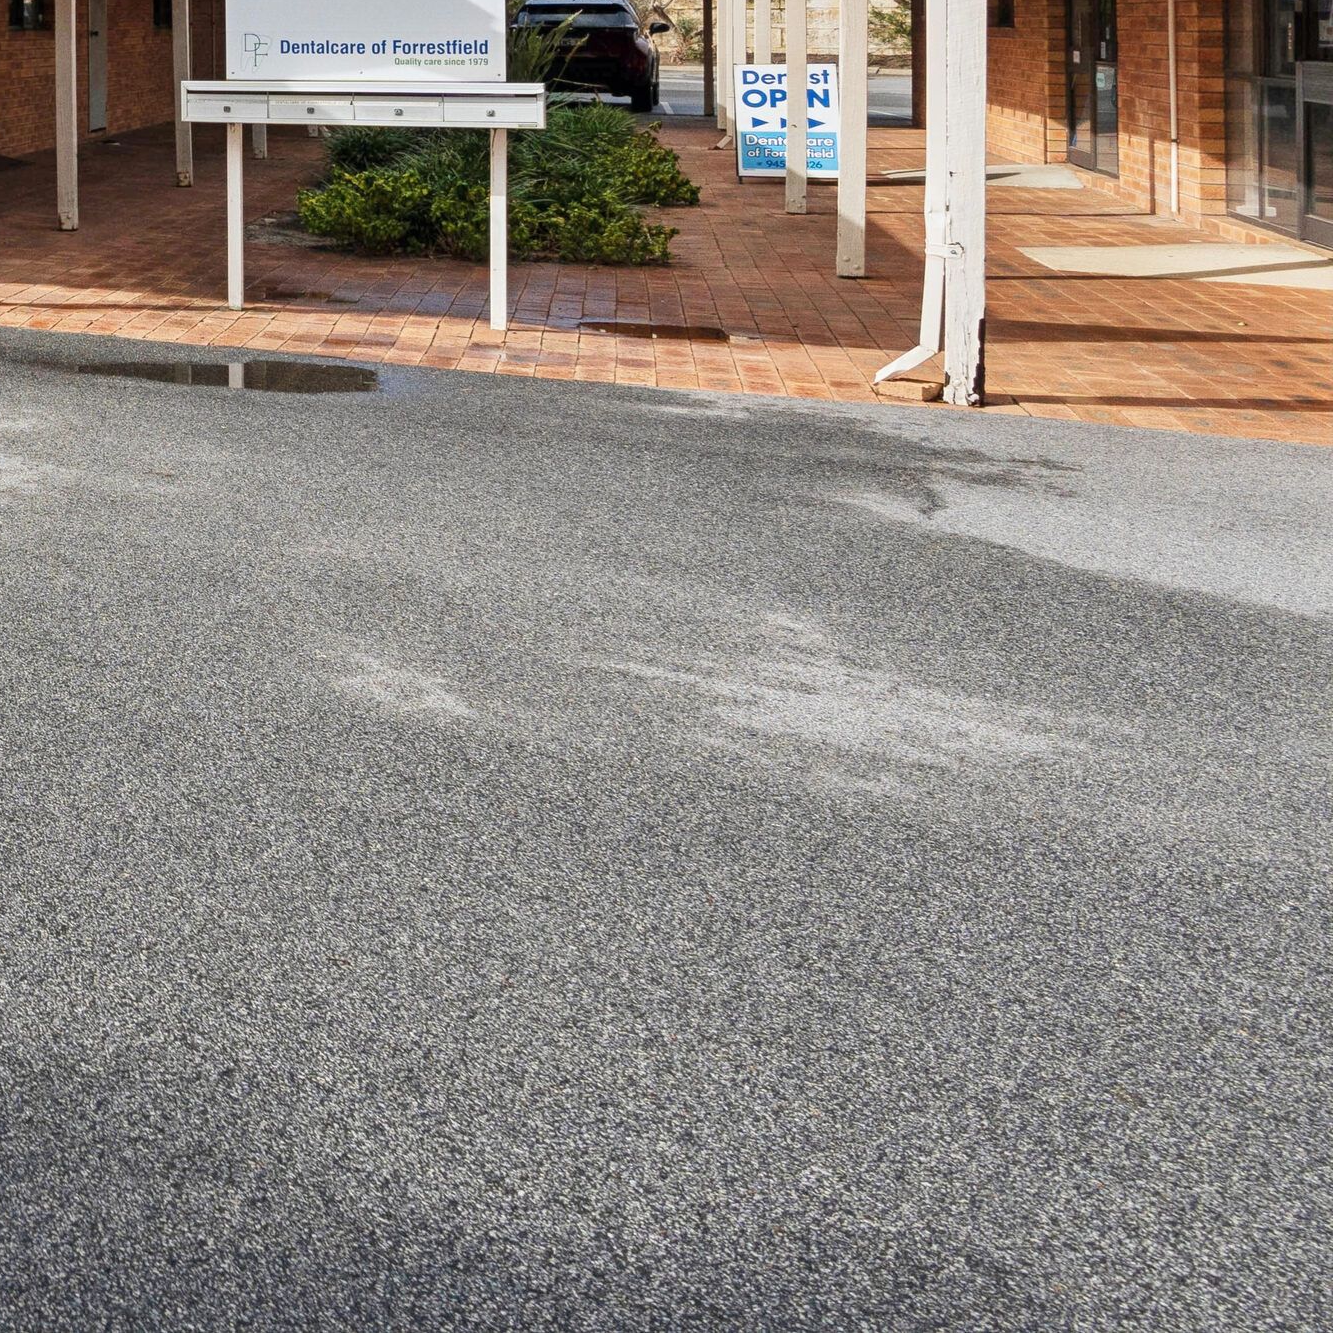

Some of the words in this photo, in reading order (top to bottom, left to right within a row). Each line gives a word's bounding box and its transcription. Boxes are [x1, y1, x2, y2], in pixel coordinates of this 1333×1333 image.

[280, 40, 366, 55] Dentalcare
[371, 40, 387, 55] of
[392, 40, 489, 55] Forrestfield
[394, 57, 422, 66] Quality
[444, 58, 466, 66] since
[468, 58, 489, 66] 1979
[742, 70, 830, 85] Denst
[741, 89, 831, 108] OPN
[745, 134, 835, 147] Dentare
[747, 148, 761, 158] of
